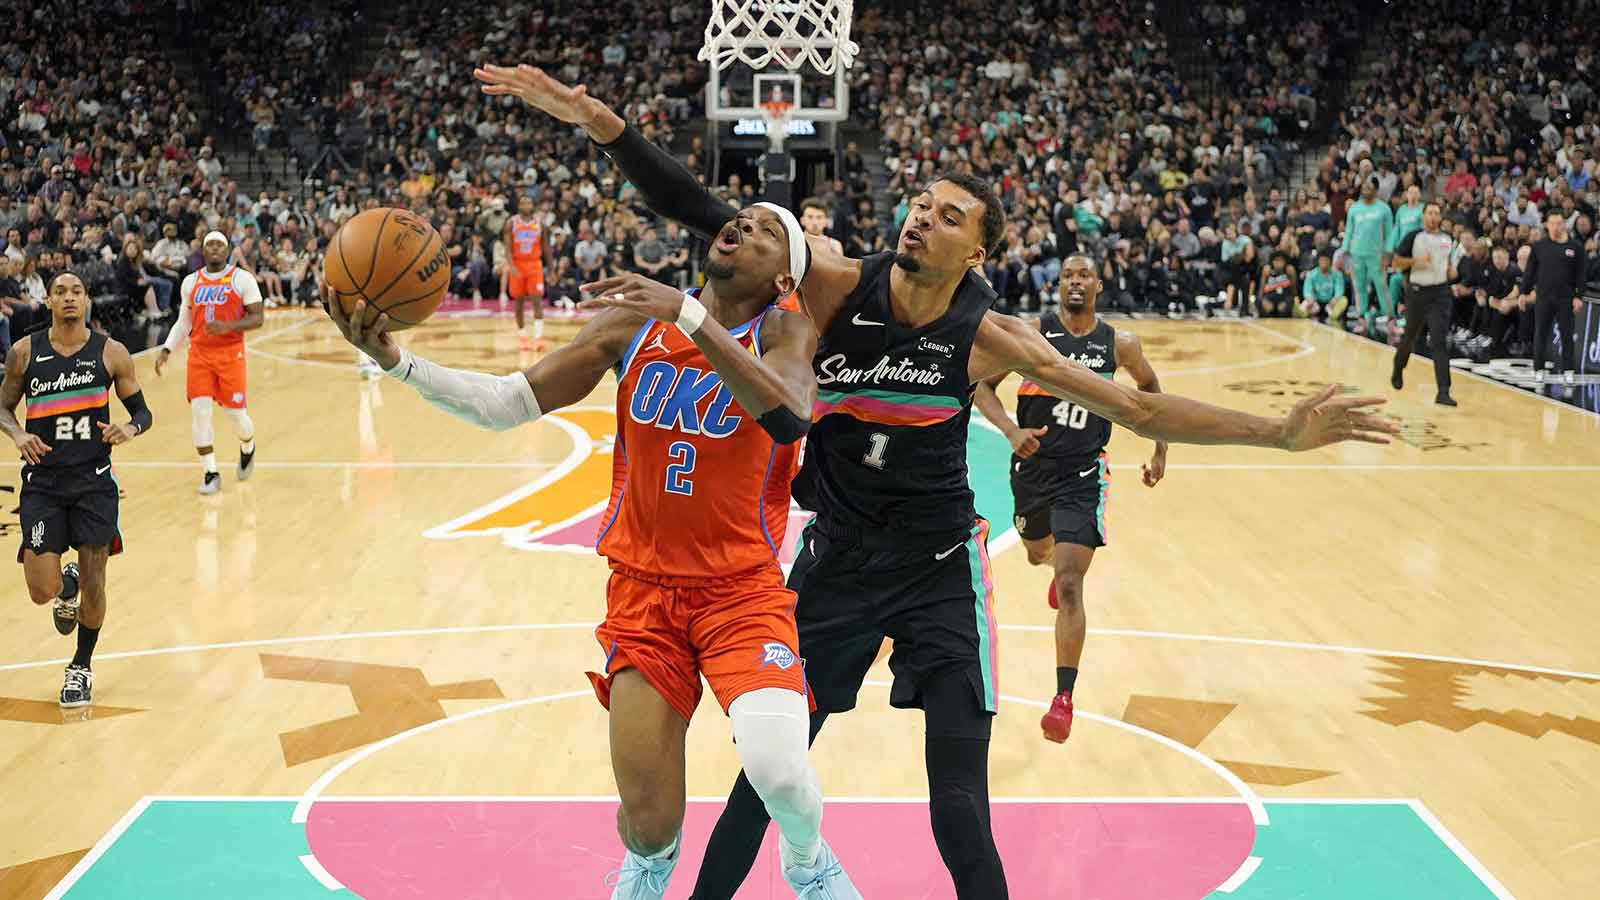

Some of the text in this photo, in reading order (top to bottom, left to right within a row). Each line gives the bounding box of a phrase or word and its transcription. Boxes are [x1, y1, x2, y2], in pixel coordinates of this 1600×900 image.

[923, 341, 949, 354] LEDGER
[30, 371, 95, 396] San Antonio
[816, 353, 945, 386] San Antonio
[629, 360, 743, 439] OKC
[55, 415, 92, 440] 24
[1052, 401, 1088, 430] 40
[863, 433, 889, 470] 1
[665, 441, 696, 496] 2
